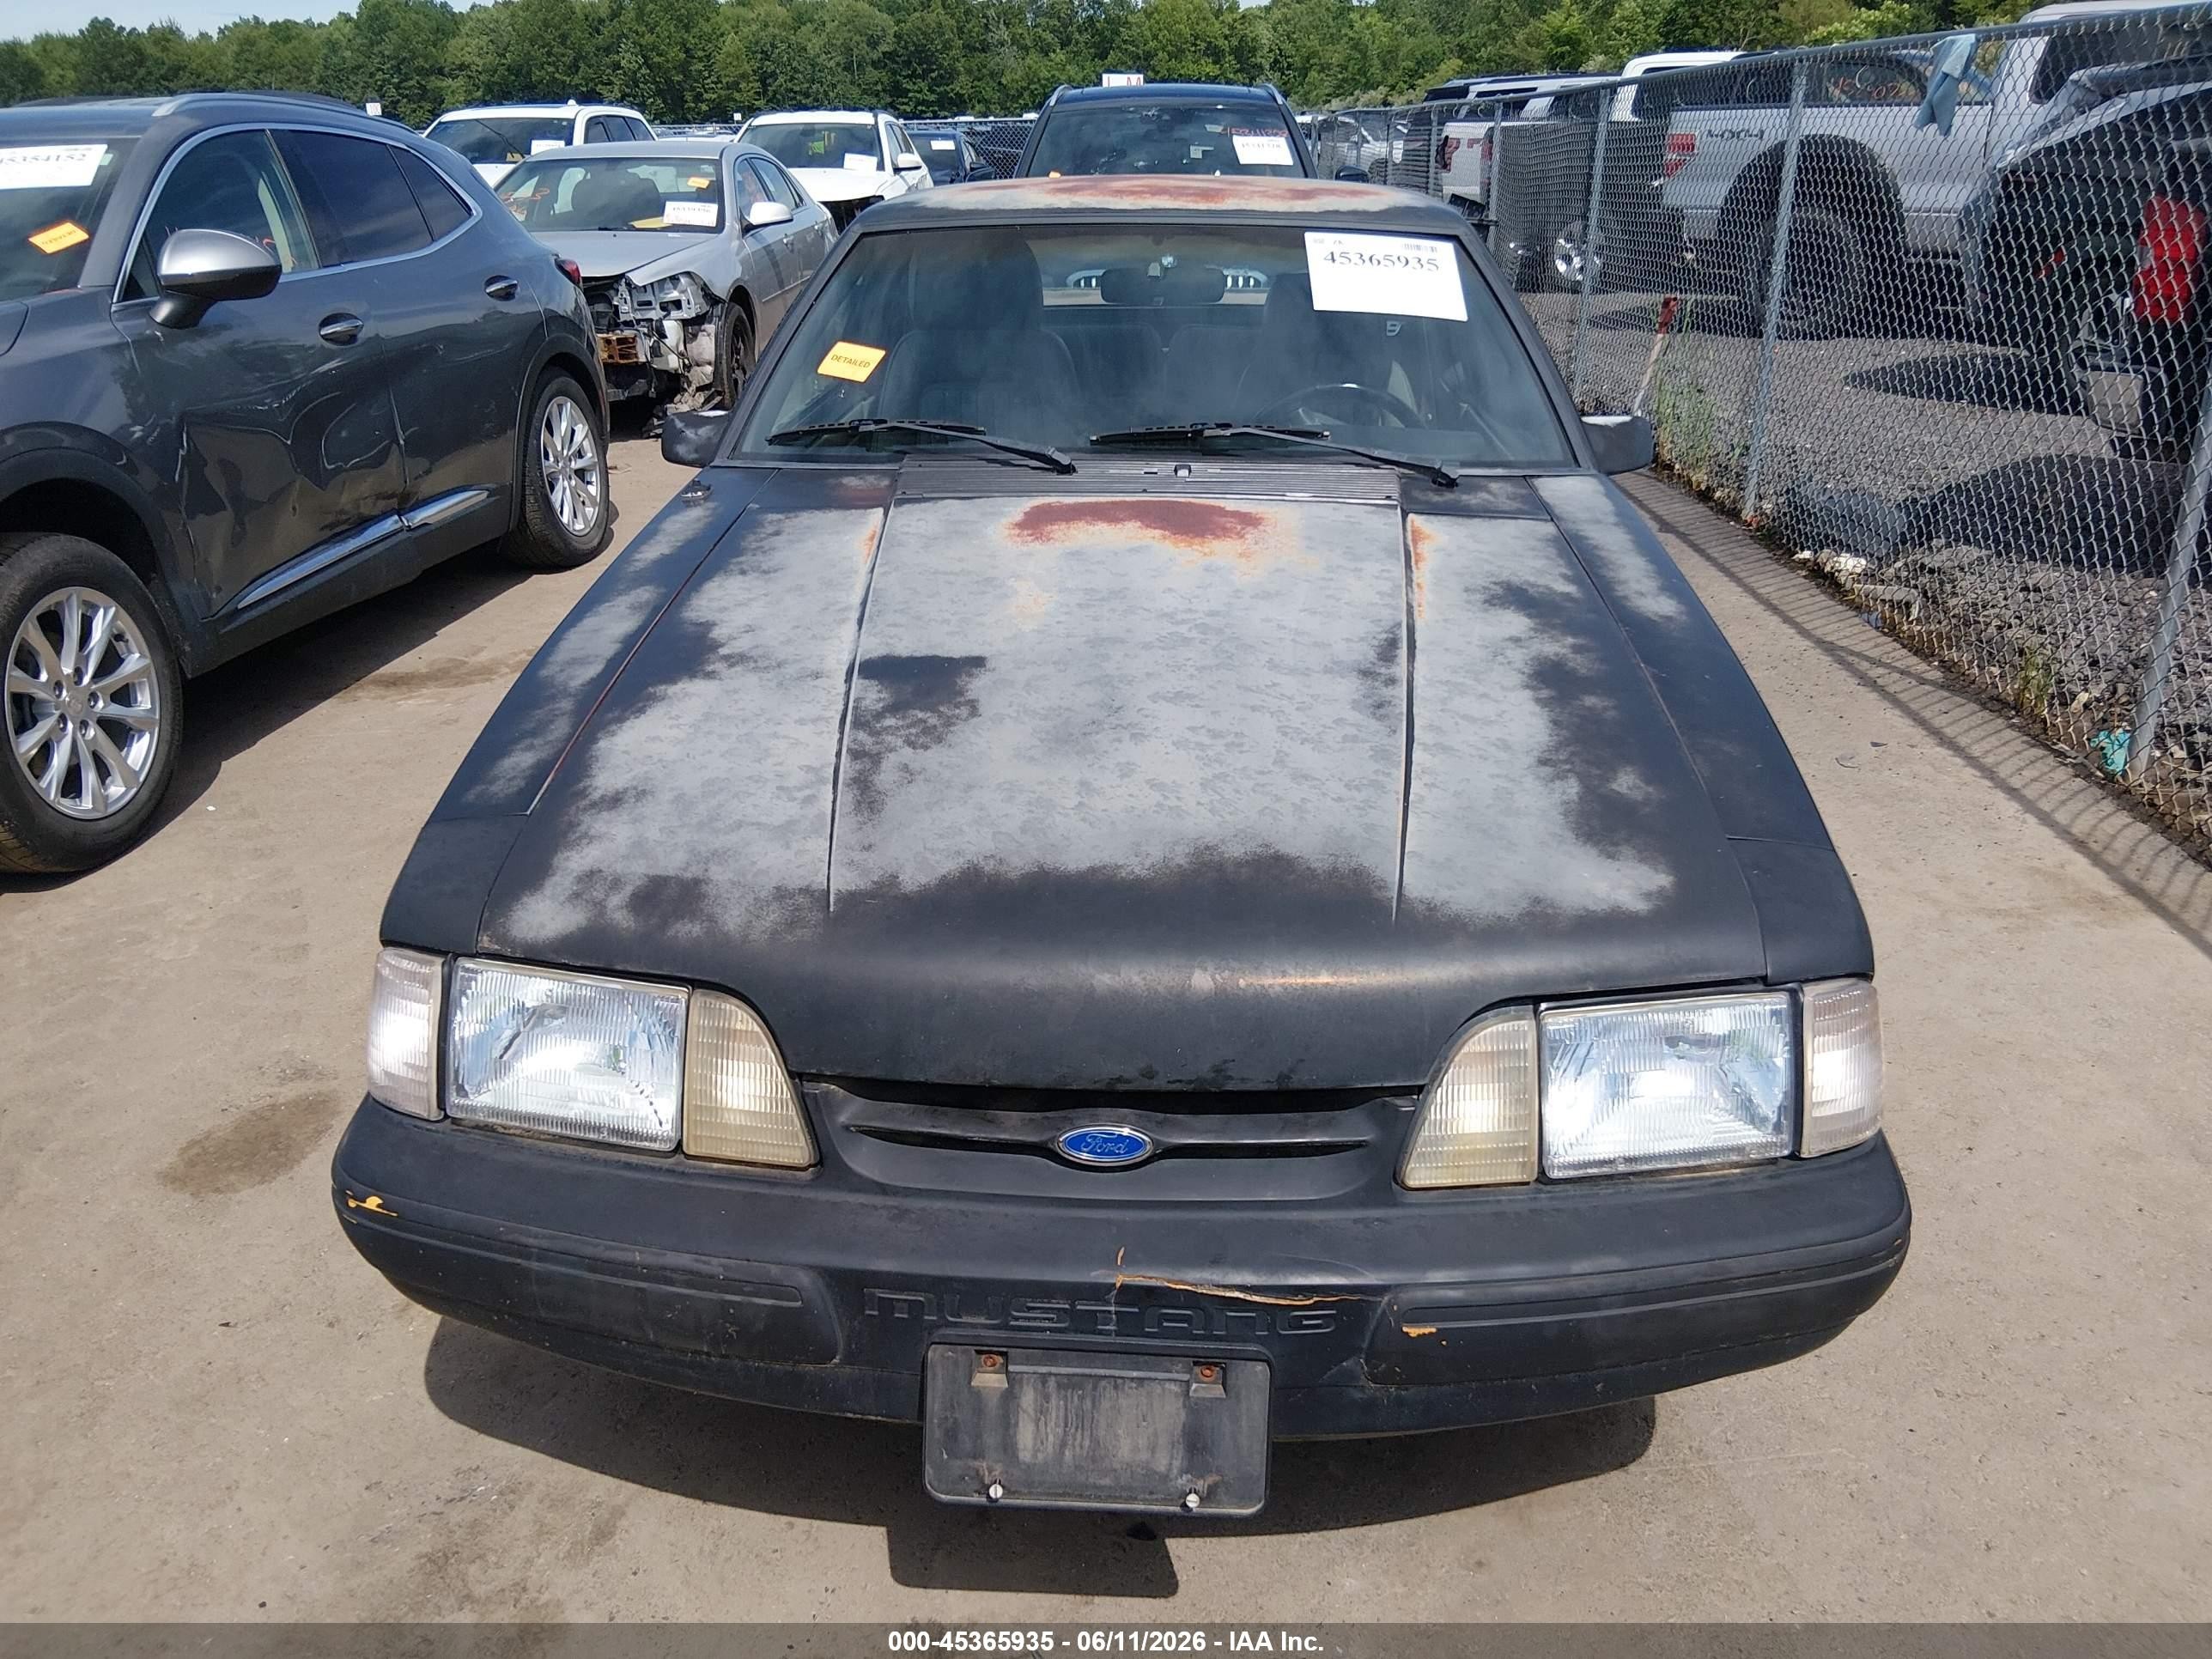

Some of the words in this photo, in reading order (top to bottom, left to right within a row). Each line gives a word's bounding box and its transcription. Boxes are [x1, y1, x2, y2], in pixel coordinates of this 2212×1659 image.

[1323, 250, 1440, 272] 45365935
[830, 353, 871, 369] DETAILED
[1079, 1132, 1129, 1154] Ford
[863, 1287, 1339, 1336] MUSTANG
